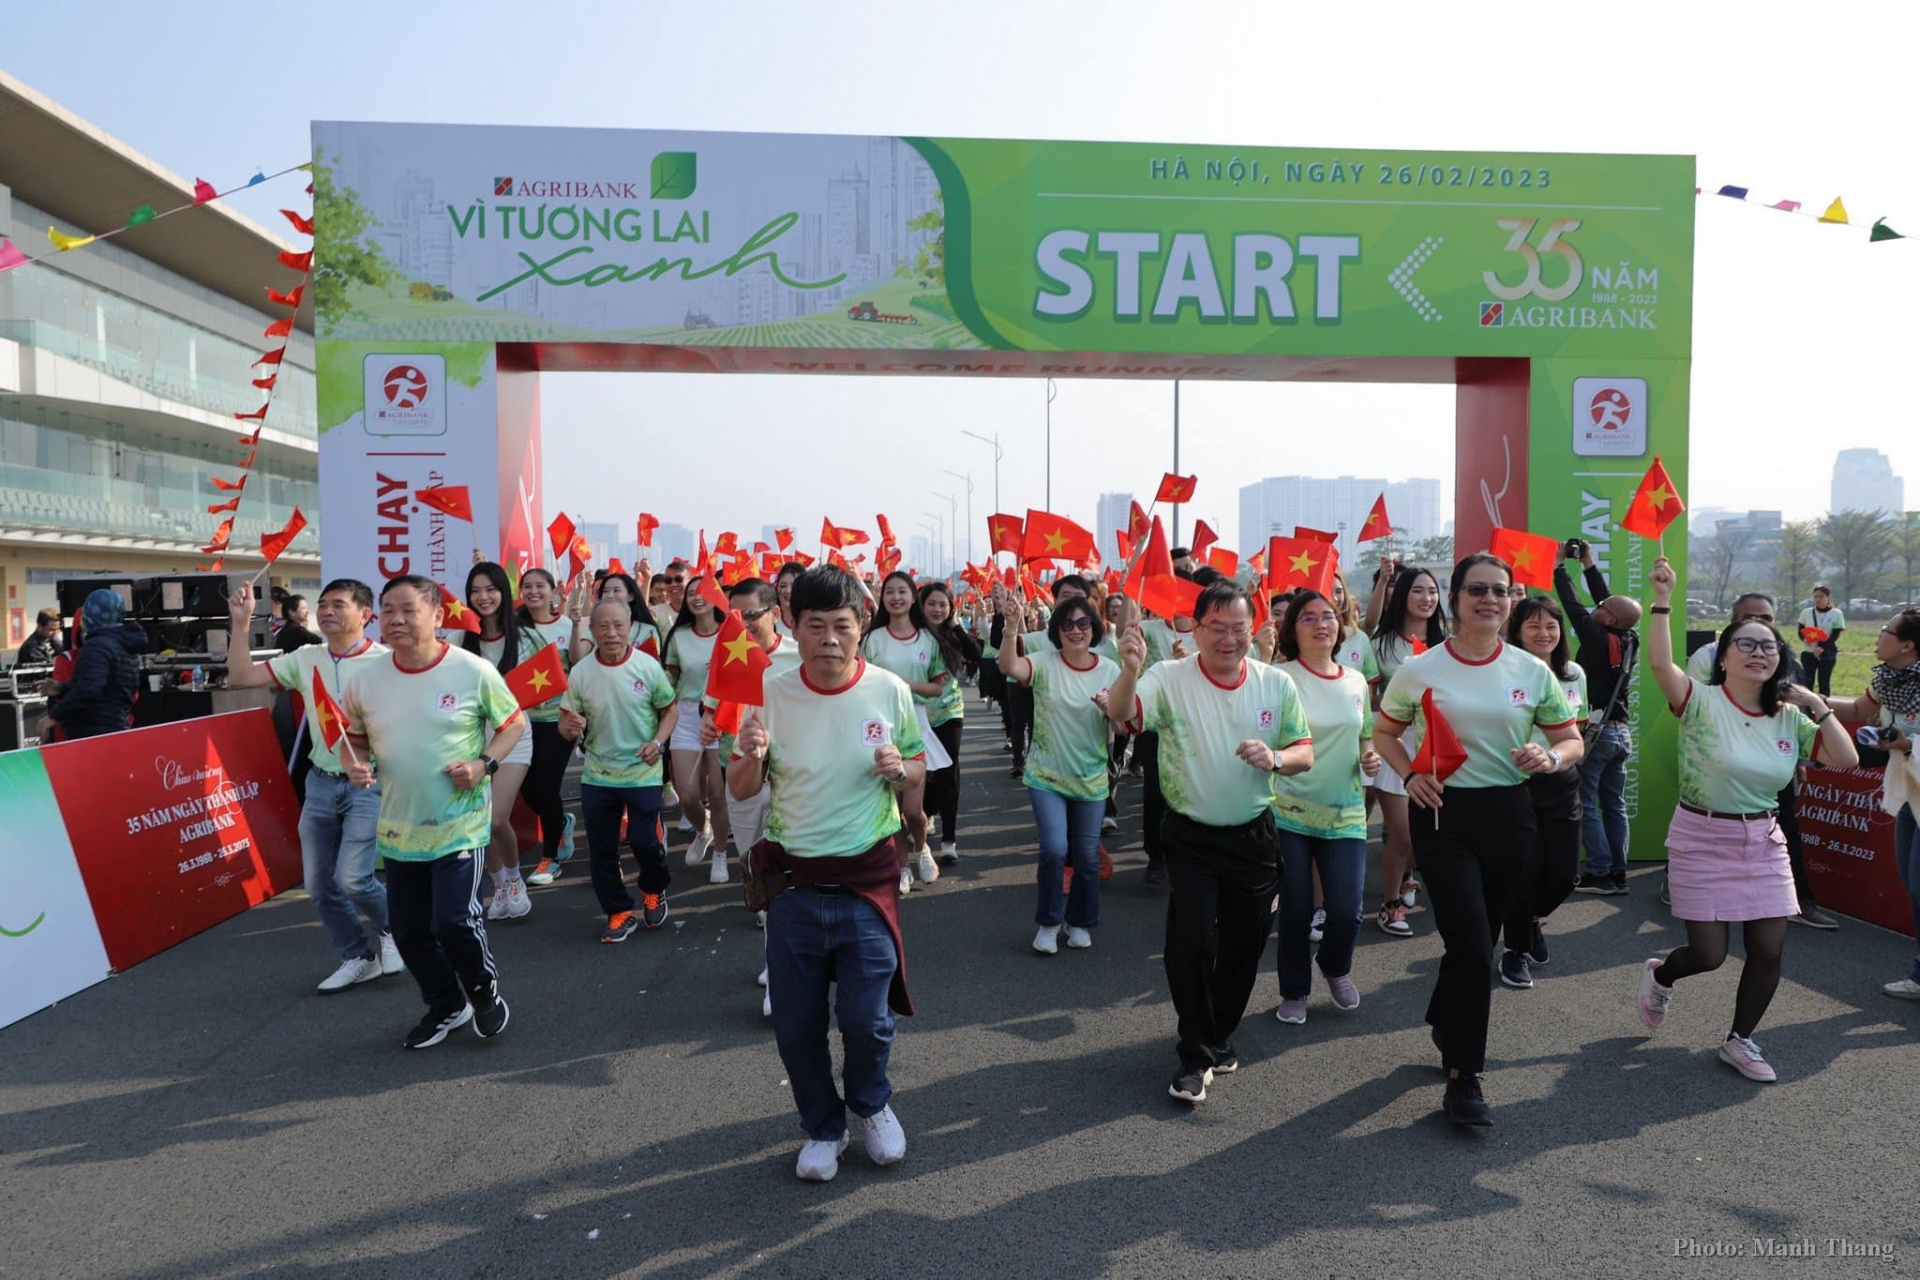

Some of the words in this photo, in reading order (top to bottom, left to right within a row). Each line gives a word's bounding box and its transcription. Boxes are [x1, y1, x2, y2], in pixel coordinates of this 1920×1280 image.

[1150, 155, 1190, 180] HÀ
[1204, 157, 1269, 185] NỘI,
[1284, 161, 1366, 185] NGÀY
[1378, 164, 1552, 189] 26/02/2023
[517, 180, 639, 199] AGRIBANK
[446, 200, 486, 239] VÌ
[653, 209, 710, 243] LAI
[1482, 217, 1584, 301] 35
[1034, 229, 1361, 322] START
[1591, 260, 1659, 291] NĂM
[1592, 293, 1617, 304] 1988
[1630, 294, 1658, 305] 2023
[1508, 306, 1658, 330] AGRIBANK
[376, 471, 419, 579] CHẠY
[1804, 783, 1845, 804] NGÀY
[126, 818, 142, 835] 35
[141, 808, 172, 830] NĂM
[171, 797, 206, 821] NGÀY
[179, 812, 236, 844] AGRIBANK
[1799, 804, 1869, 832] AGRIBANK
[1827, 840, 1875, 861] 26.3.2023
